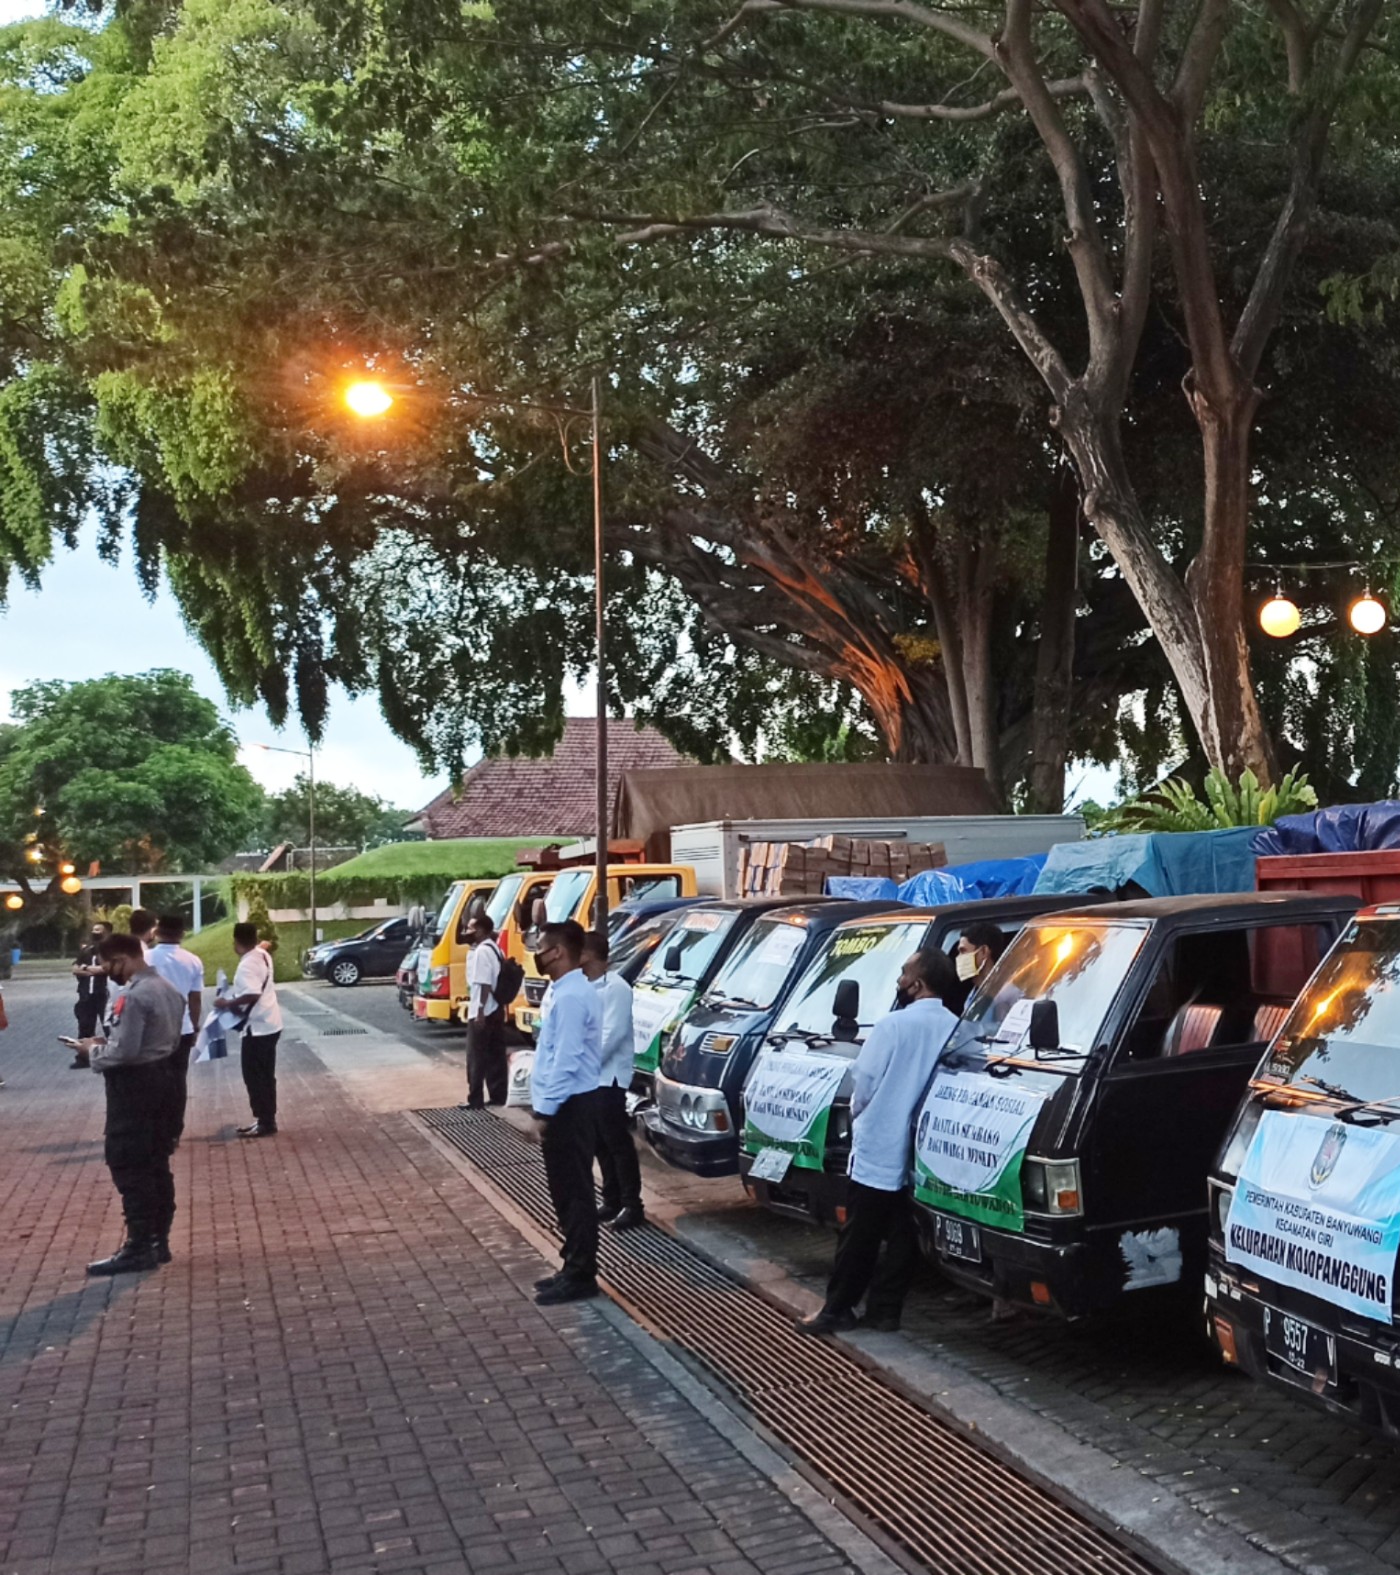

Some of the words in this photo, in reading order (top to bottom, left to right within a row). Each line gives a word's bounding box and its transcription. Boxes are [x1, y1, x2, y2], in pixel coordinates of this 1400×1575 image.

[995, 1095, 1026, 1115] SOSIAL
[927, 1137, 942, 1155] BAGI
[942, 1142, 966, 1161] WARGA
[967, 1146, 999, 1168] MISKIN
[936, 1215, 941, 1236] P
[1245, 1191, 1284, 1212] PEMERINTAH
[1283, 1202, 1326, 1227] KABUPATEN
[1326, 1216, 1384, 1245] BANYUWANGI
[1275, 1218, 1316, 1241] KECAMATAN
[1317, 1233, 1334, 1248] GIRI
[1230, 1223, 1287, 1267] KELURAHAN
[1286, 1243, 1387, 1304] MOJOPANGGUNG
[1263, 1306, 1271, 1335] P
[1283, 1316, 1308, 1355] 9557
[1326, 1336, 1334, 1367] V
